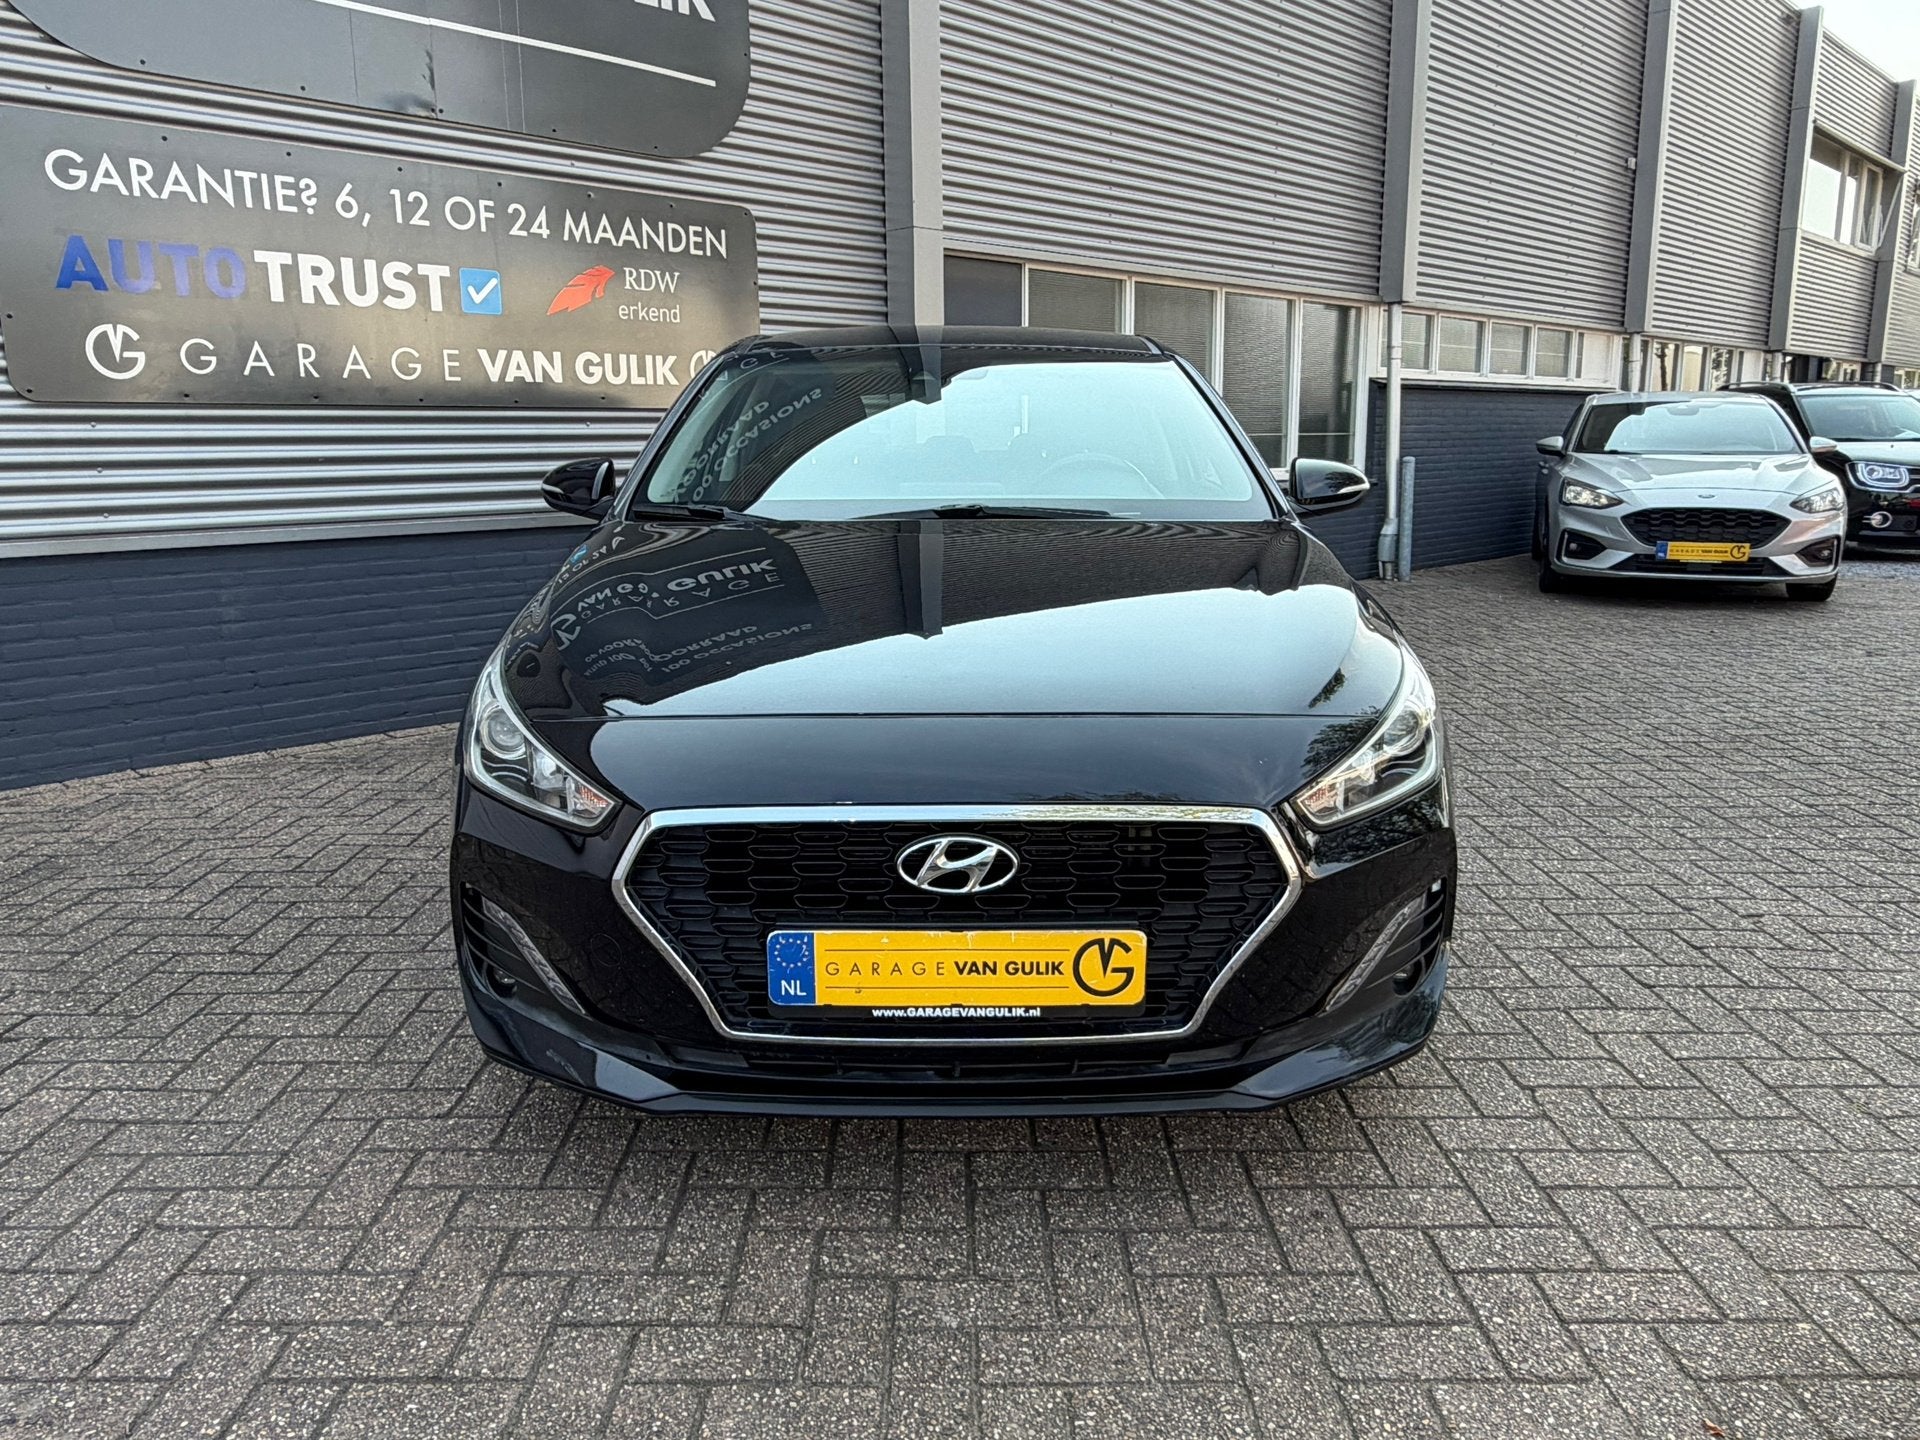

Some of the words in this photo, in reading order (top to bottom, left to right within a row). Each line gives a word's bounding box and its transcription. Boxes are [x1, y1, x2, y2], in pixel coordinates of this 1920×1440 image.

[45, 149, 318, 215] GARANTIE?
[335, 182, 372, 227] 6,
[389, 188, 431, 227] 12
[444, 195, 496, 233] OF
[507, 203, 550, 239] 24
[563, 208, 728, 260] MAANDEN
[623, 266, 681, 294] RDW
[618, 301, 681, 323] erkend
[179, 338, 461, 381] GARAGE
[477, 348, 563, 384] VAN
[574, 352, 680, 386] GULIK
[825, 960, 947, 977] GARAGE
[953, 960, 998, 977] VAN
[1004, 960, 1065, 977] GULIK
[780, 979, 807, 997] NL
[871, 1006, 1041, 1018] www.GARAGEVANGULIK.nl
